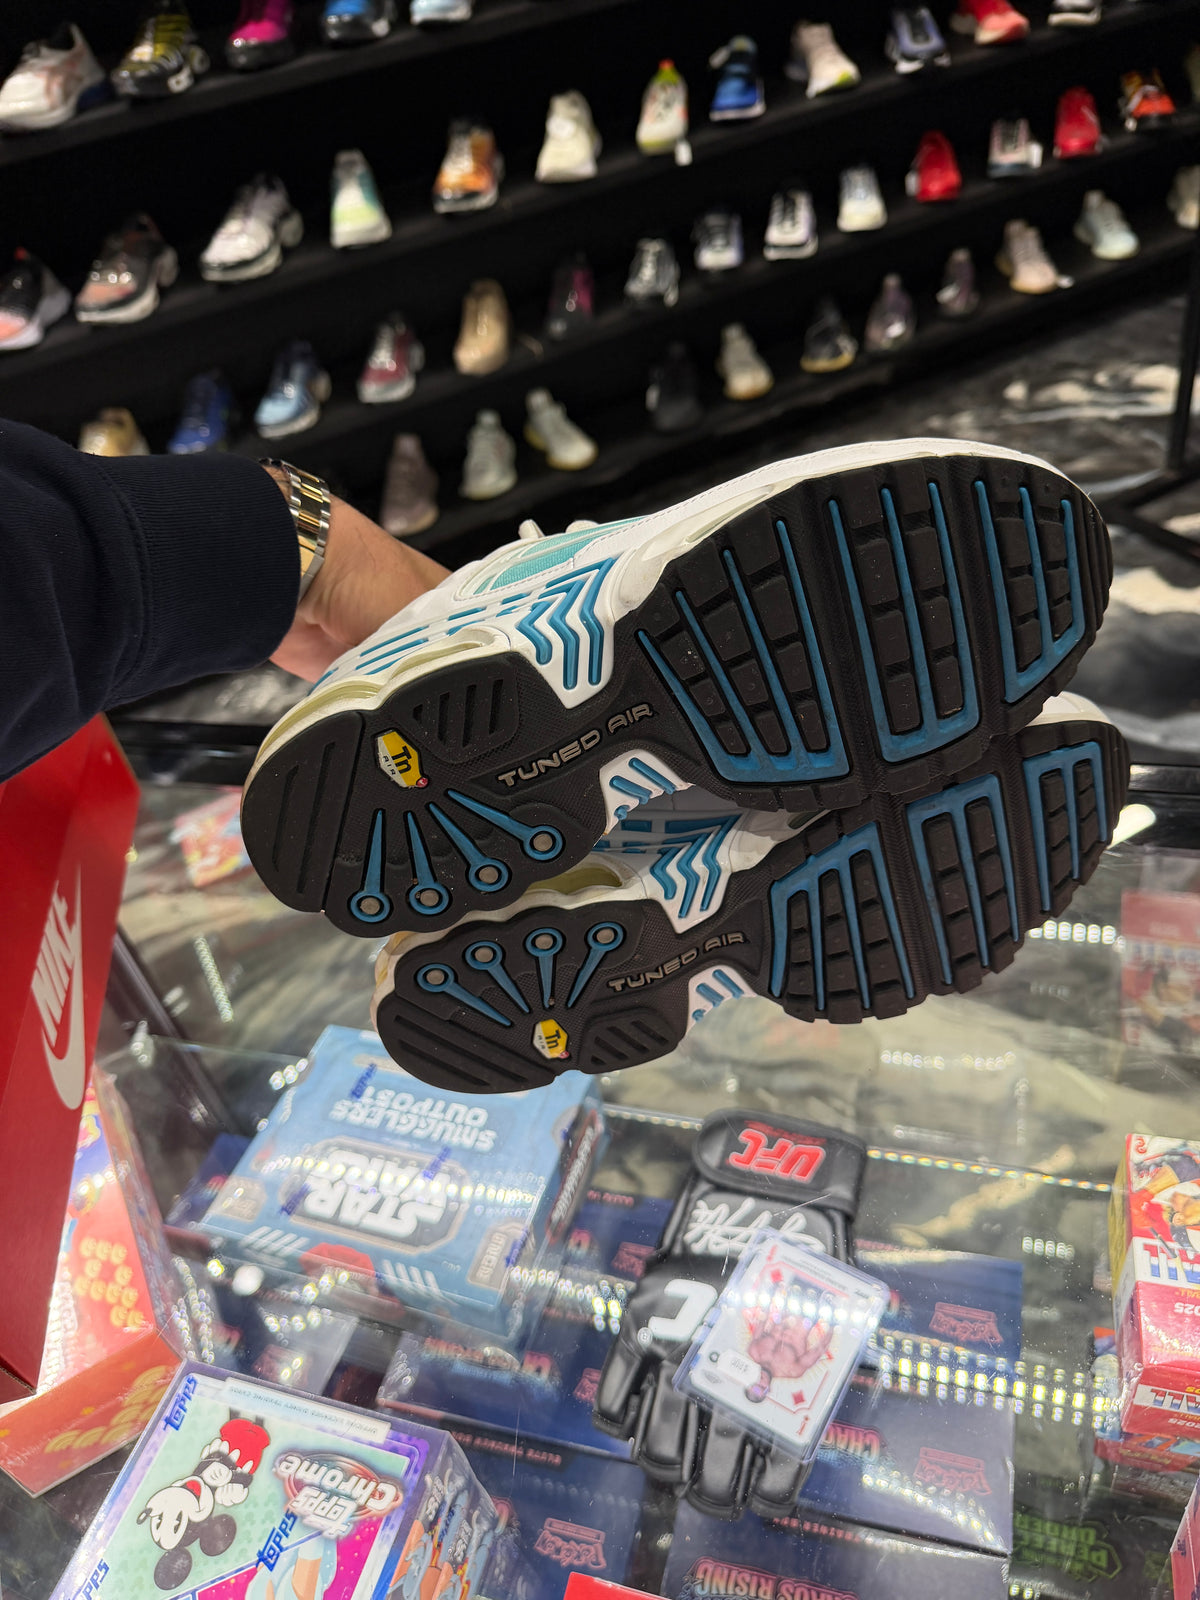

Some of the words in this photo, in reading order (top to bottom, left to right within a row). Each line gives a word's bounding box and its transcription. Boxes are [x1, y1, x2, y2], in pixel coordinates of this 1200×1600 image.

[382, 755, 396, 776] AIR
[498, 730, 600, 787] TUNED
[607, 703, 653, 734] AIR
[31, 879, 73, 1048] NIKE
[607, 949, 698, 991] TUNED
[703, 932, 747, 952] AIR
[329, 1098, 498, 1152] SMUGGLERS
[360, 1085, 489, 1127] OUTPOST
[728, 1130, 827, 1183] UFC
[303, 1175, 445, 1238] STAR
[279, 1454, 397, 1511] Chrome
[288, 1486, 358, 1538] topps
[255, 1508, 299, 1572] topps
[695, 1559, 777, 1599] RISING
